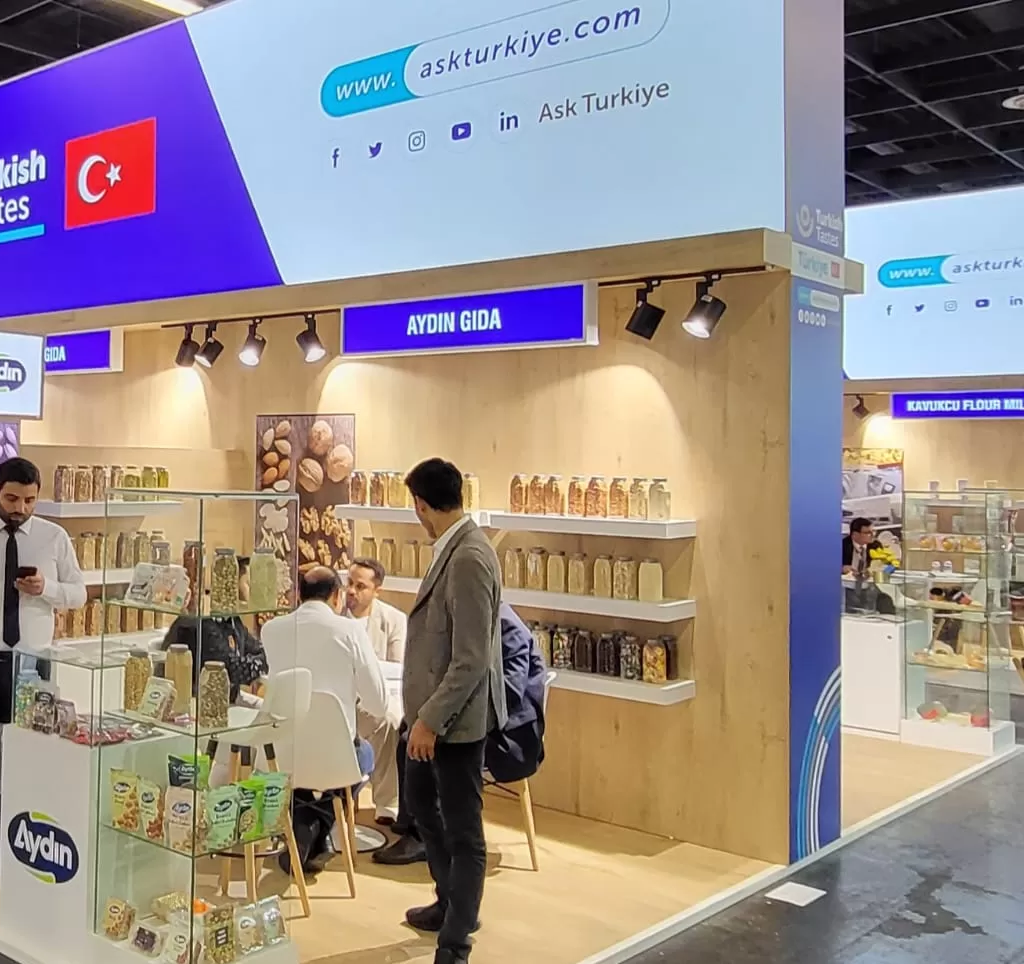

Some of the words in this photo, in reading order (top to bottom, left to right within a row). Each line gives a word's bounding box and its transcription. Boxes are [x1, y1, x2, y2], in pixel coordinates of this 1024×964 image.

[334, 73, 397, 101] www.
[419, 5, 642, 79] askturkiye.com
[538, 97, 578, 124] Ask
[582, 79, 671, 115] Turkiye
[888, 265, 936, 280] www.
[406, 311, 455, 336] AYDIN
[459, 308, 502, 332] GIDA
[962, 398, 1001, 411] FLOUR
